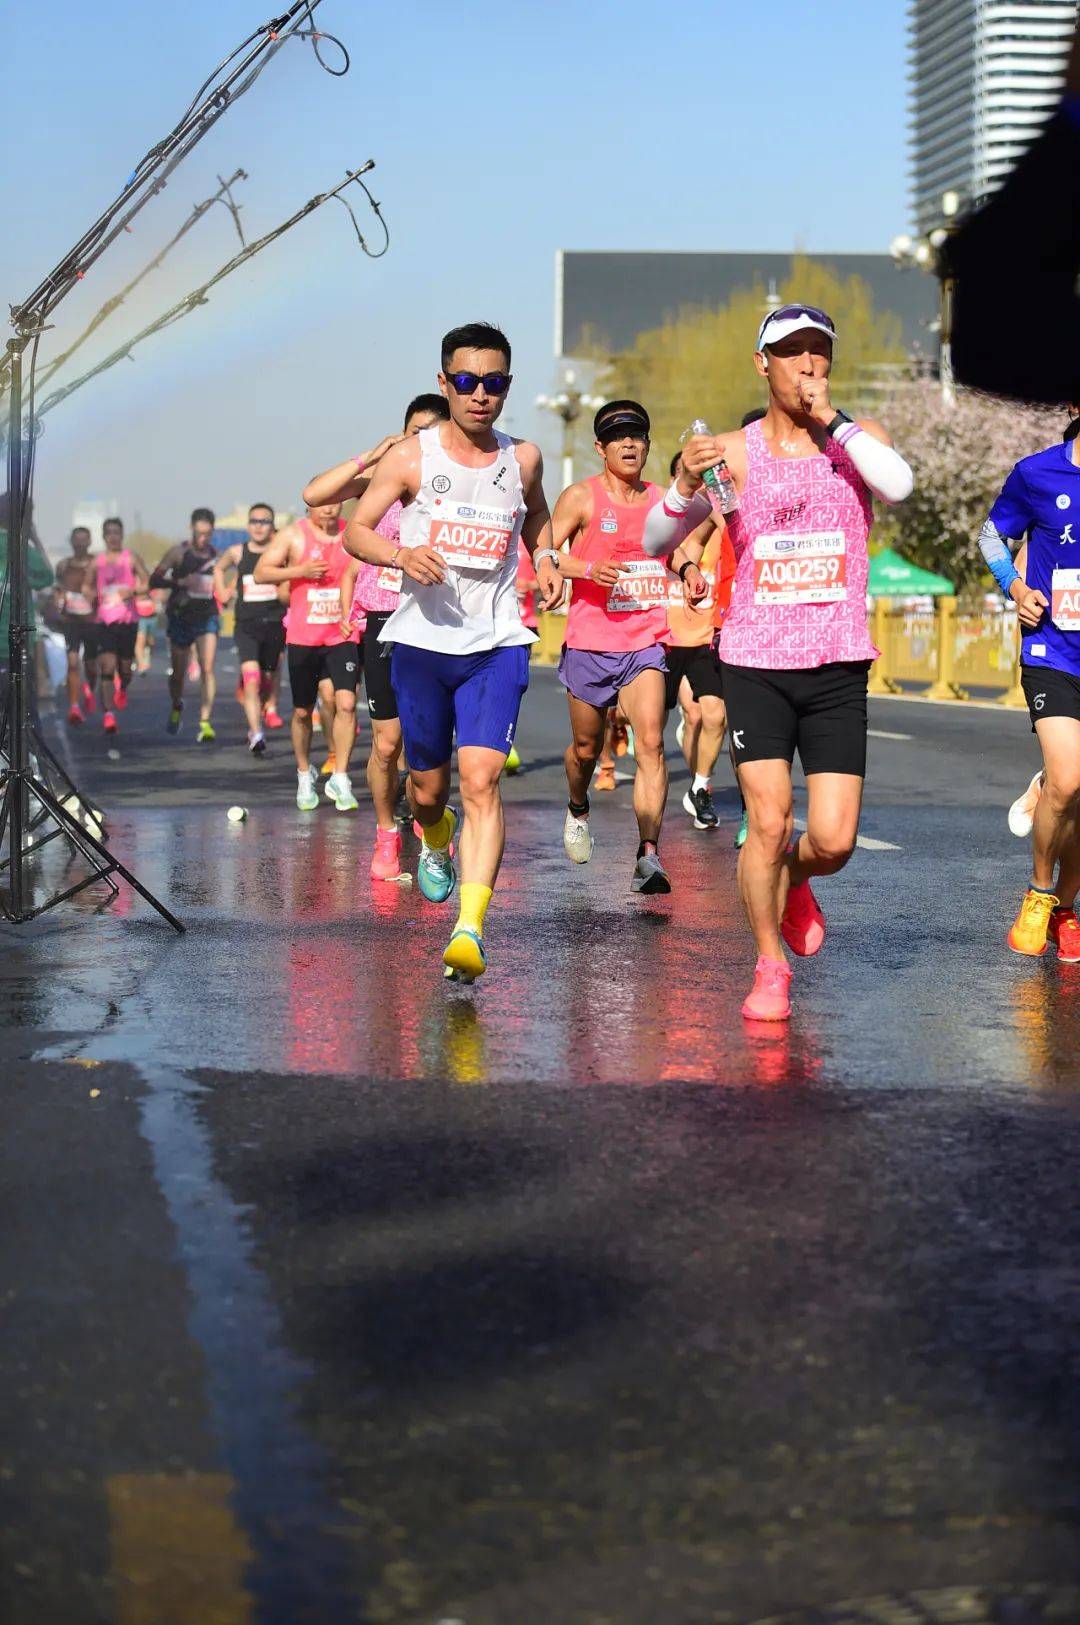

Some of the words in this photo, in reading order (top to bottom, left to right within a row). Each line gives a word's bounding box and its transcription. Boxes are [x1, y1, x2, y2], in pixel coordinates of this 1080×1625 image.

[435, 524, 509, 553] A00275
[758, 558, 840, 585] A00259
[611, 579, 666, 598] A00166
